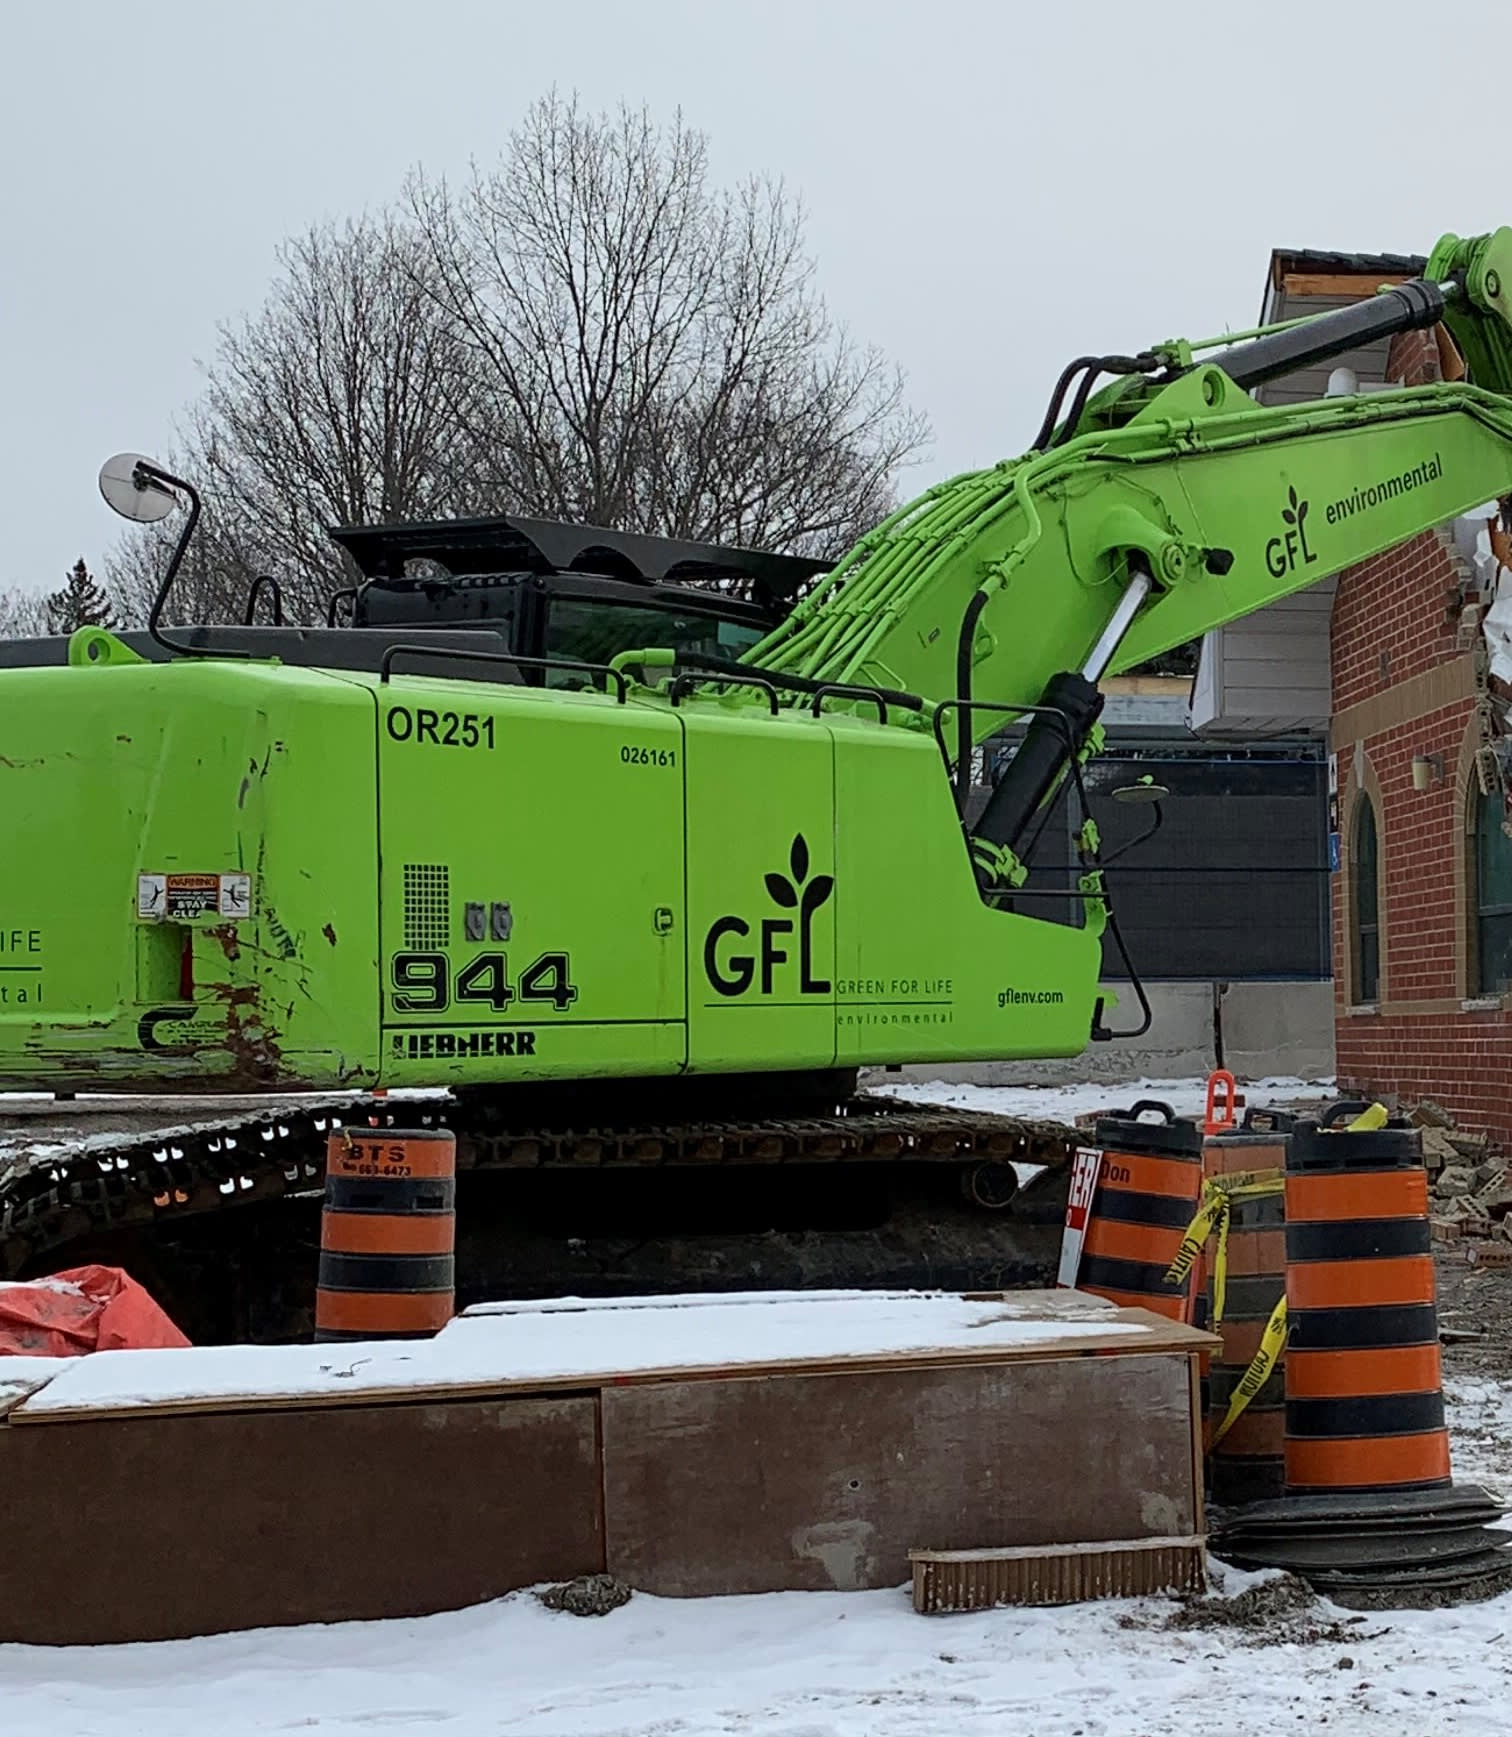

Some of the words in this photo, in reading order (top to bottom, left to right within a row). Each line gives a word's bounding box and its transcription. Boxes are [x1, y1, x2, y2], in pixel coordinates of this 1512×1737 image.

[1265, 500, 1318, 579] GFL
[1325, 452, 1443, 525] environmental
[386, 705, 496, 750] OR251
[620, 745, 677, 768] 026161
[0, 930, 42, 952] IFE
[703, 874, 834, 997] GFL
[390, 950, 579, 1014] 944
[836, 980, 886, 995] GREEN
[891, 980, 920, 994] FOR
[924, 979, 953, 993] LIFE
[997, 987, 1065, 1008] gflenv.com
[837, 1011, 954, 1026] environmental
[347, 1144, 406, 1163] BTS
